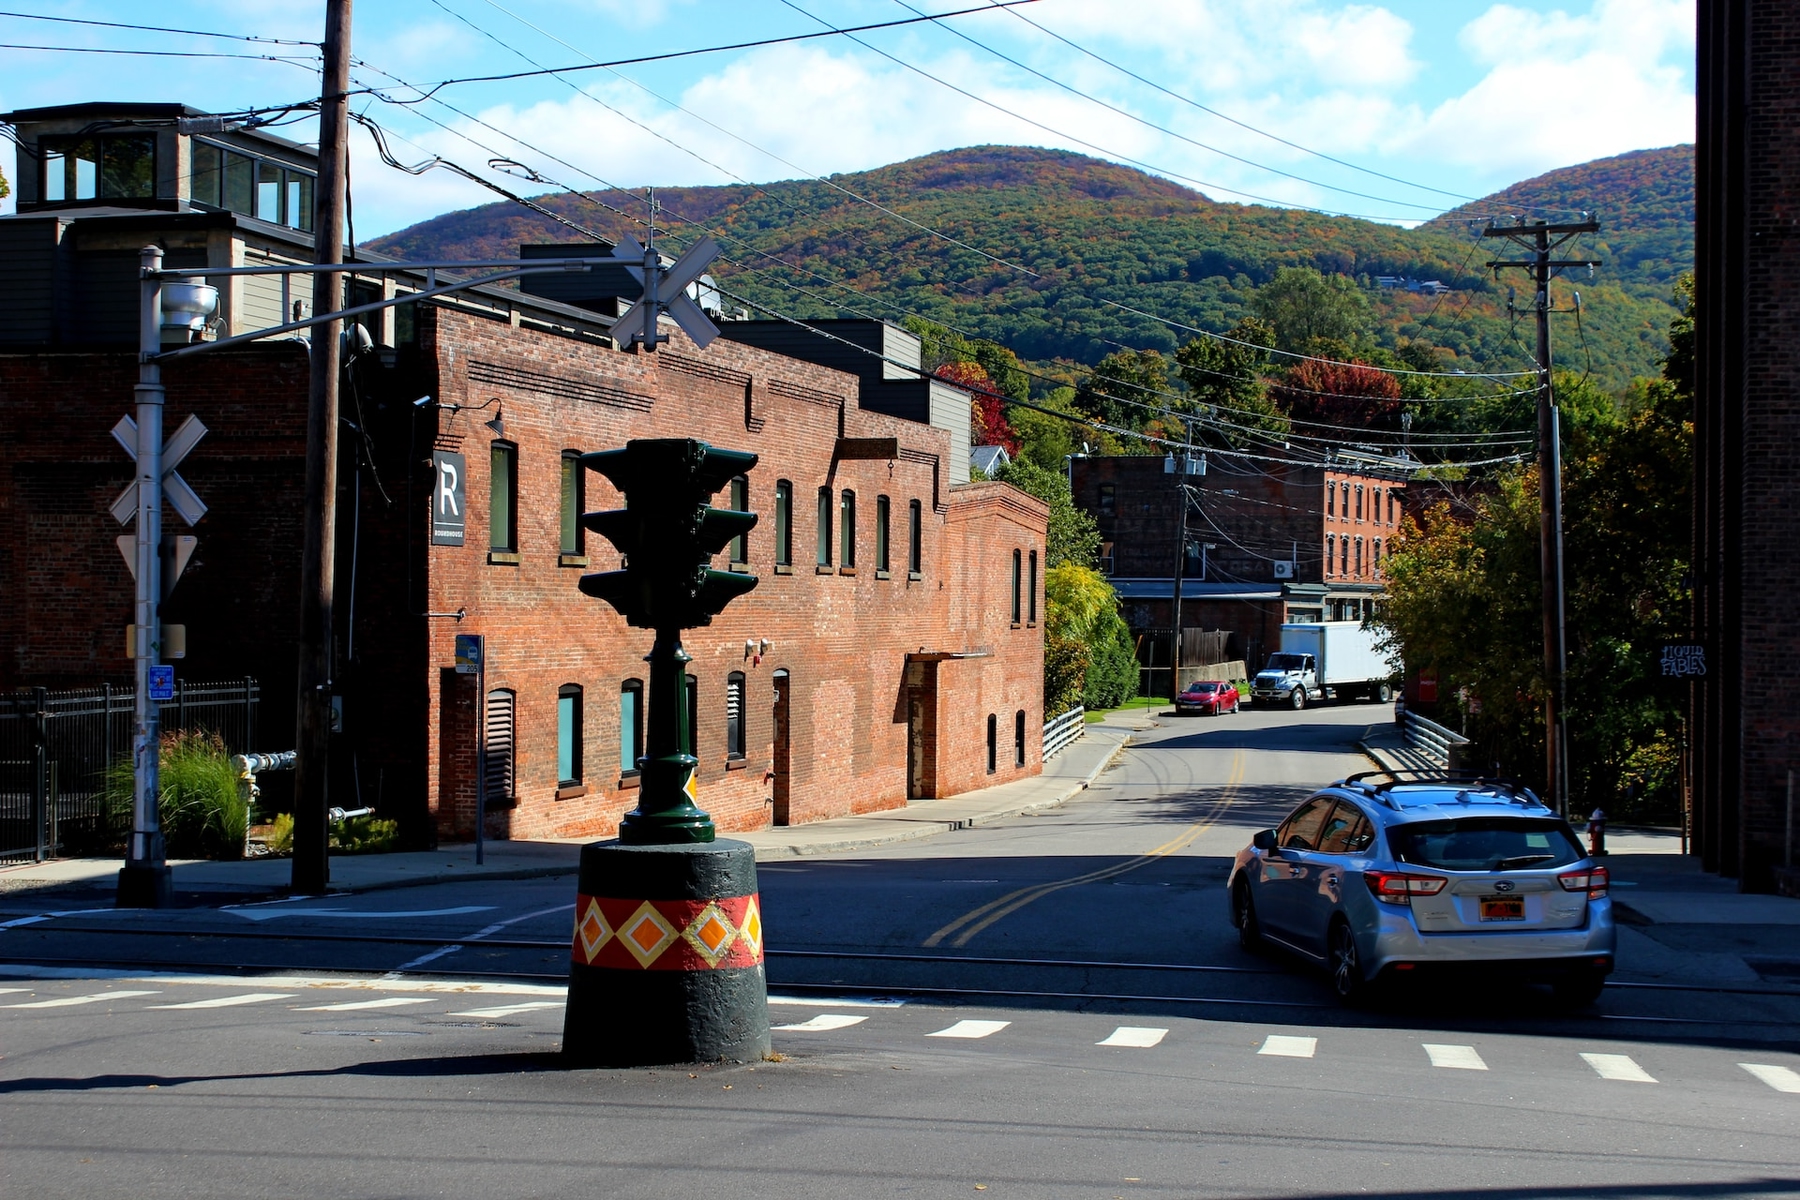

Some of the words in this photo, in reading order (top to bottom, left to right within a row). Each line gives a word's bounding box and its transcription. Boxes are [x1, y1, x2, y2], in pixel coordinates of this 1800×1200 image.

[440, 459, 459, 516] R
[434, 529, 464, 538] ROUNDHOUSE
[1660, 645, 1706, 662] LIQUID
[1660, 655, 1707, 678] FABLES
